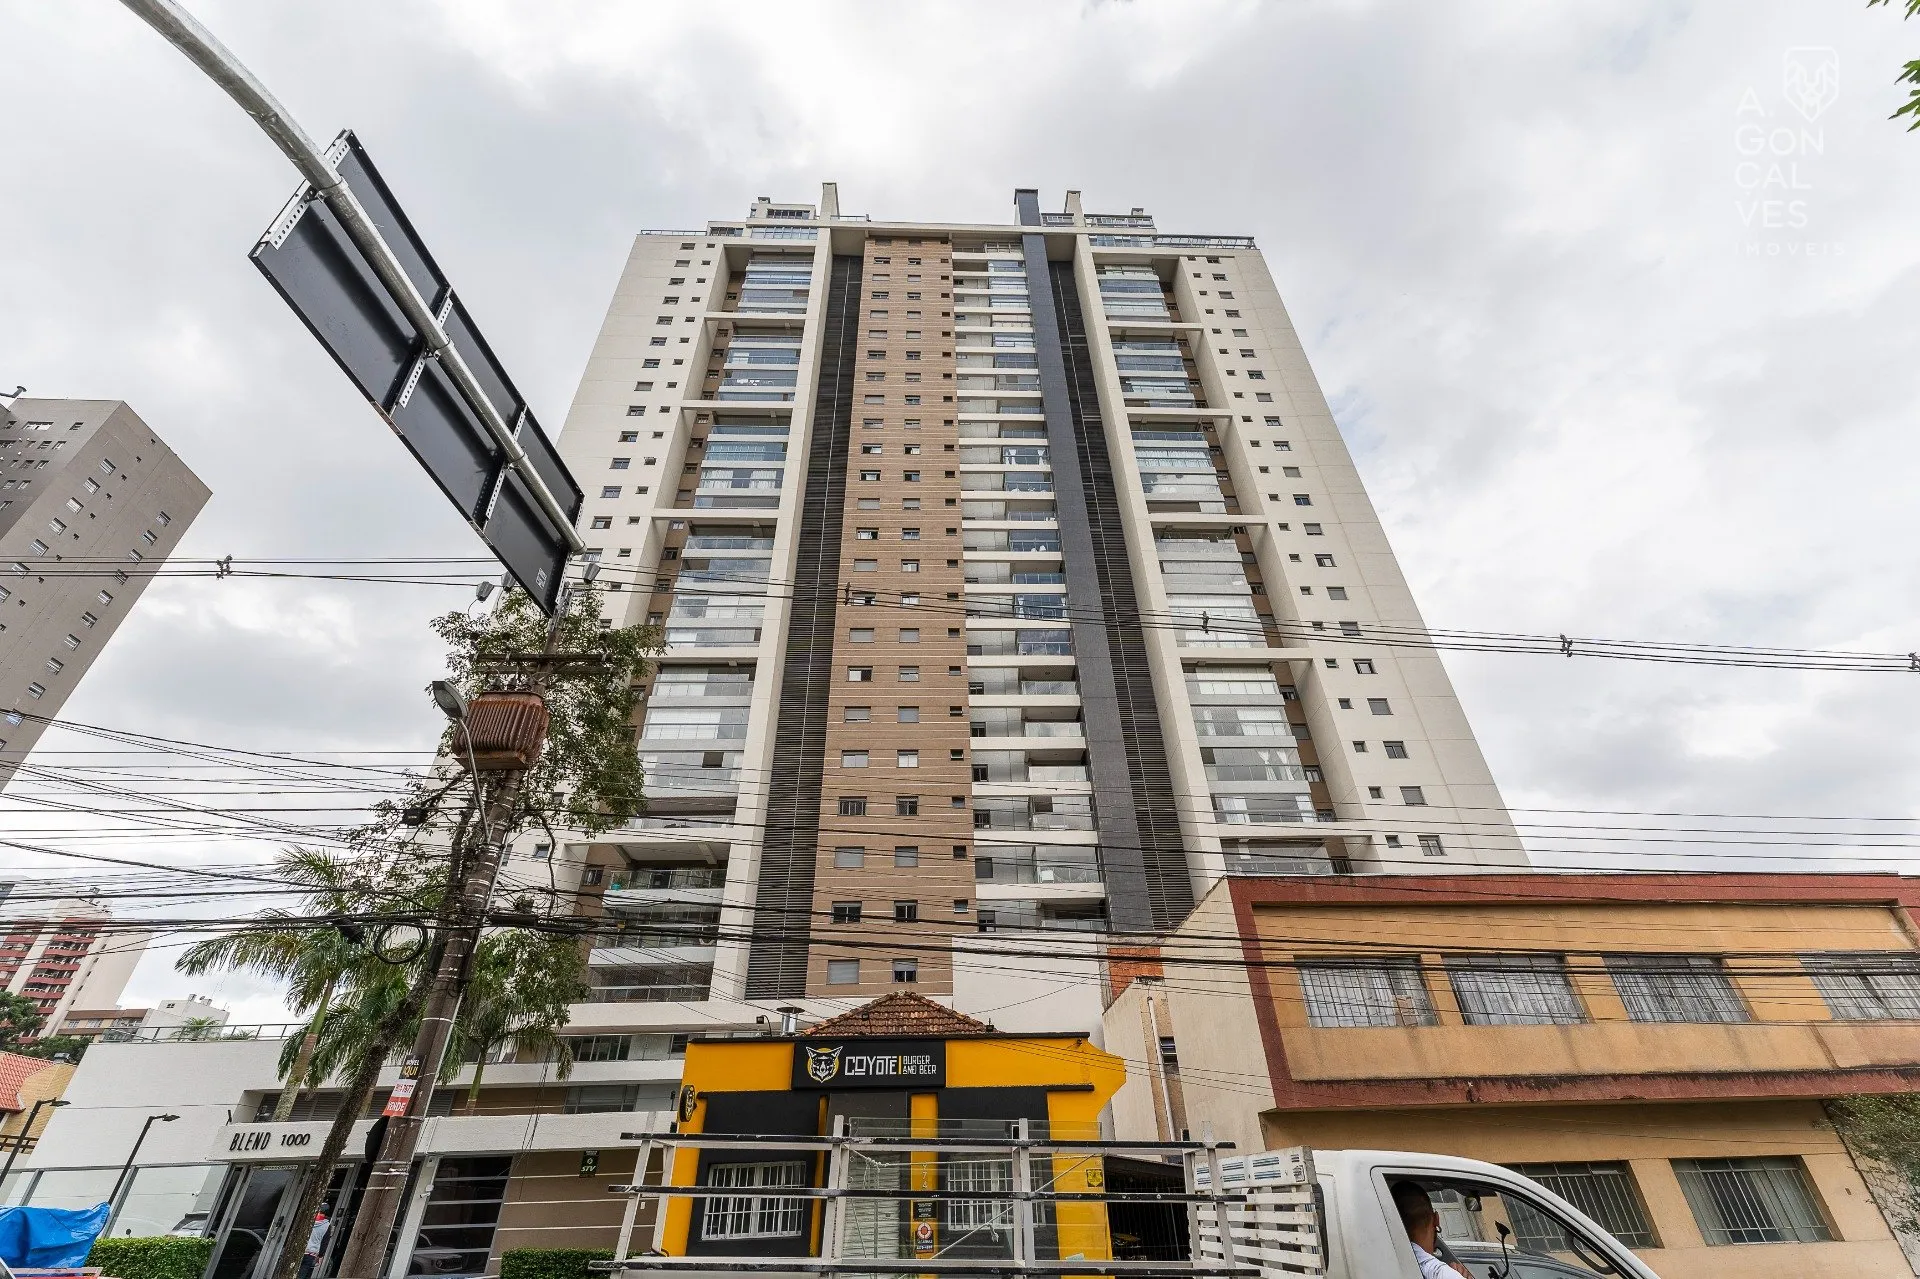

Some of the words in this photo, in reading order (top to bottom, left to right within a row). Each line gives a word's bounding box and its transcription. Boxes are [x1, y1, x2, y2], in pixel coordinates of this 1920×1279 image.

[844, 1055, 898, 1076] COYOTE
[902, 1055, 931, 1065] BURGER
[902, 1065, 917, 1075] AND
[918, 1064, 937, 1075] BEER
[229, 1131, 272, 1152] BLEND
[280, 1133, 311, 1147] 1000
